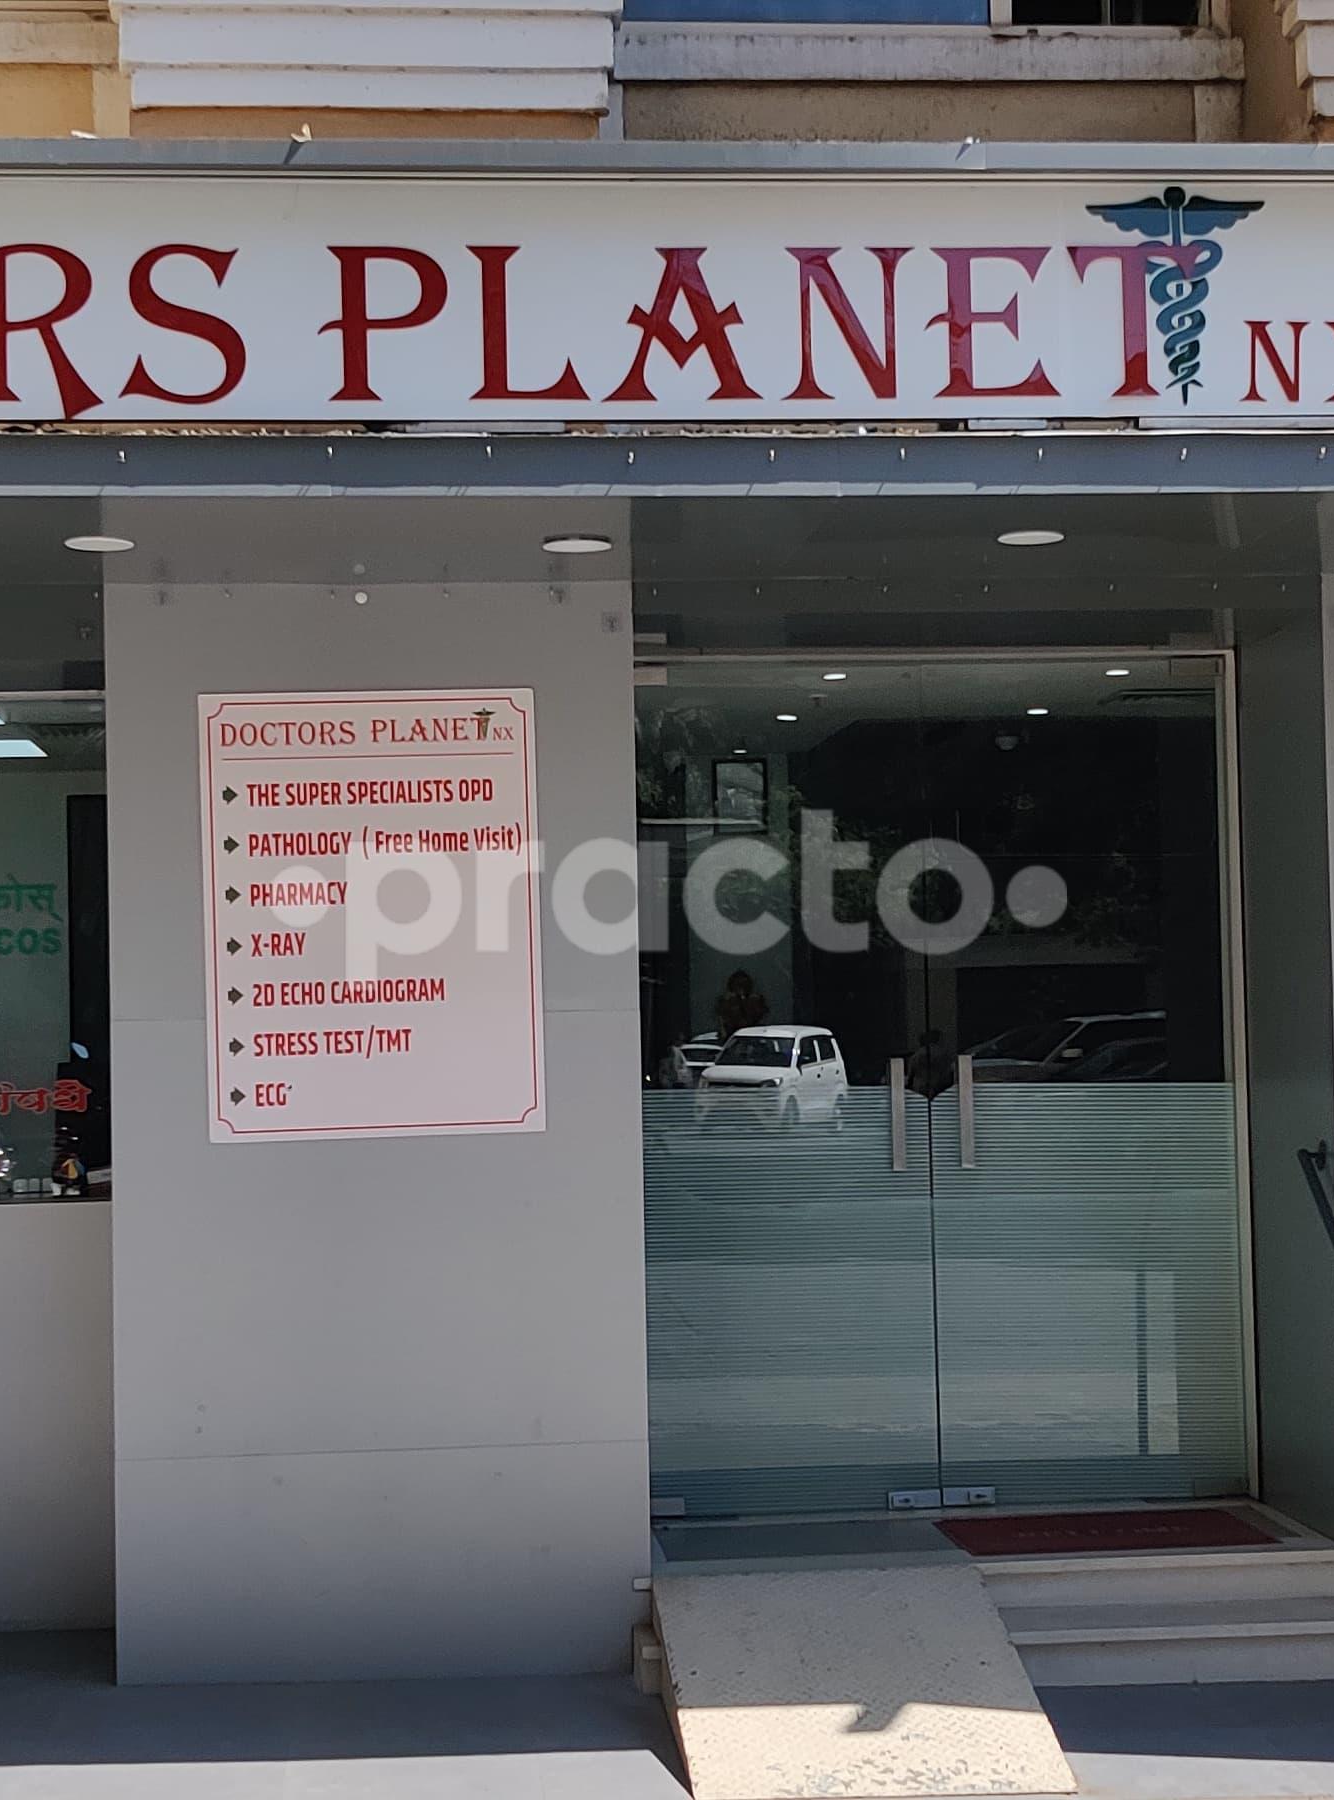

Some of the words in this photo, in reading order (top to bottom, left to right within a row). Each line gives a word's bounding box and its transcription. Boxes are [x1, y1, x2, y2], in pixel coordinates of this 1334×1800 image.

[317, 245, 1221, 401] PLANET
[220, 720, 356, 747] DOCTORS
[371, 717, 490, 742] PLANET
[493, 727, 514, 741] NX
[247, 783, 280, 807] THE
[286, 782, 341, 806] SUPER
[347, 780, 453, 804] SPECIALISTS
[459, 779, 493, 801] OPD
[249, 831, 352, 857] PATHOLOGY
[419, 828, 468, 852] Home
[474, 822, 522, 856] Visit)
[250, 881, 347, 907] PHARMACY
[251, 932, 306, 957] X-RAY
[253, 983, 274, 1007] 2D
[281, 981, 325, 1005] ECHO
[331, 978, 445, 1004] CARDIOGRAM
[253, 1031, 317, 1057] STRESS
[256, 1082, 287, 1107] ECG
